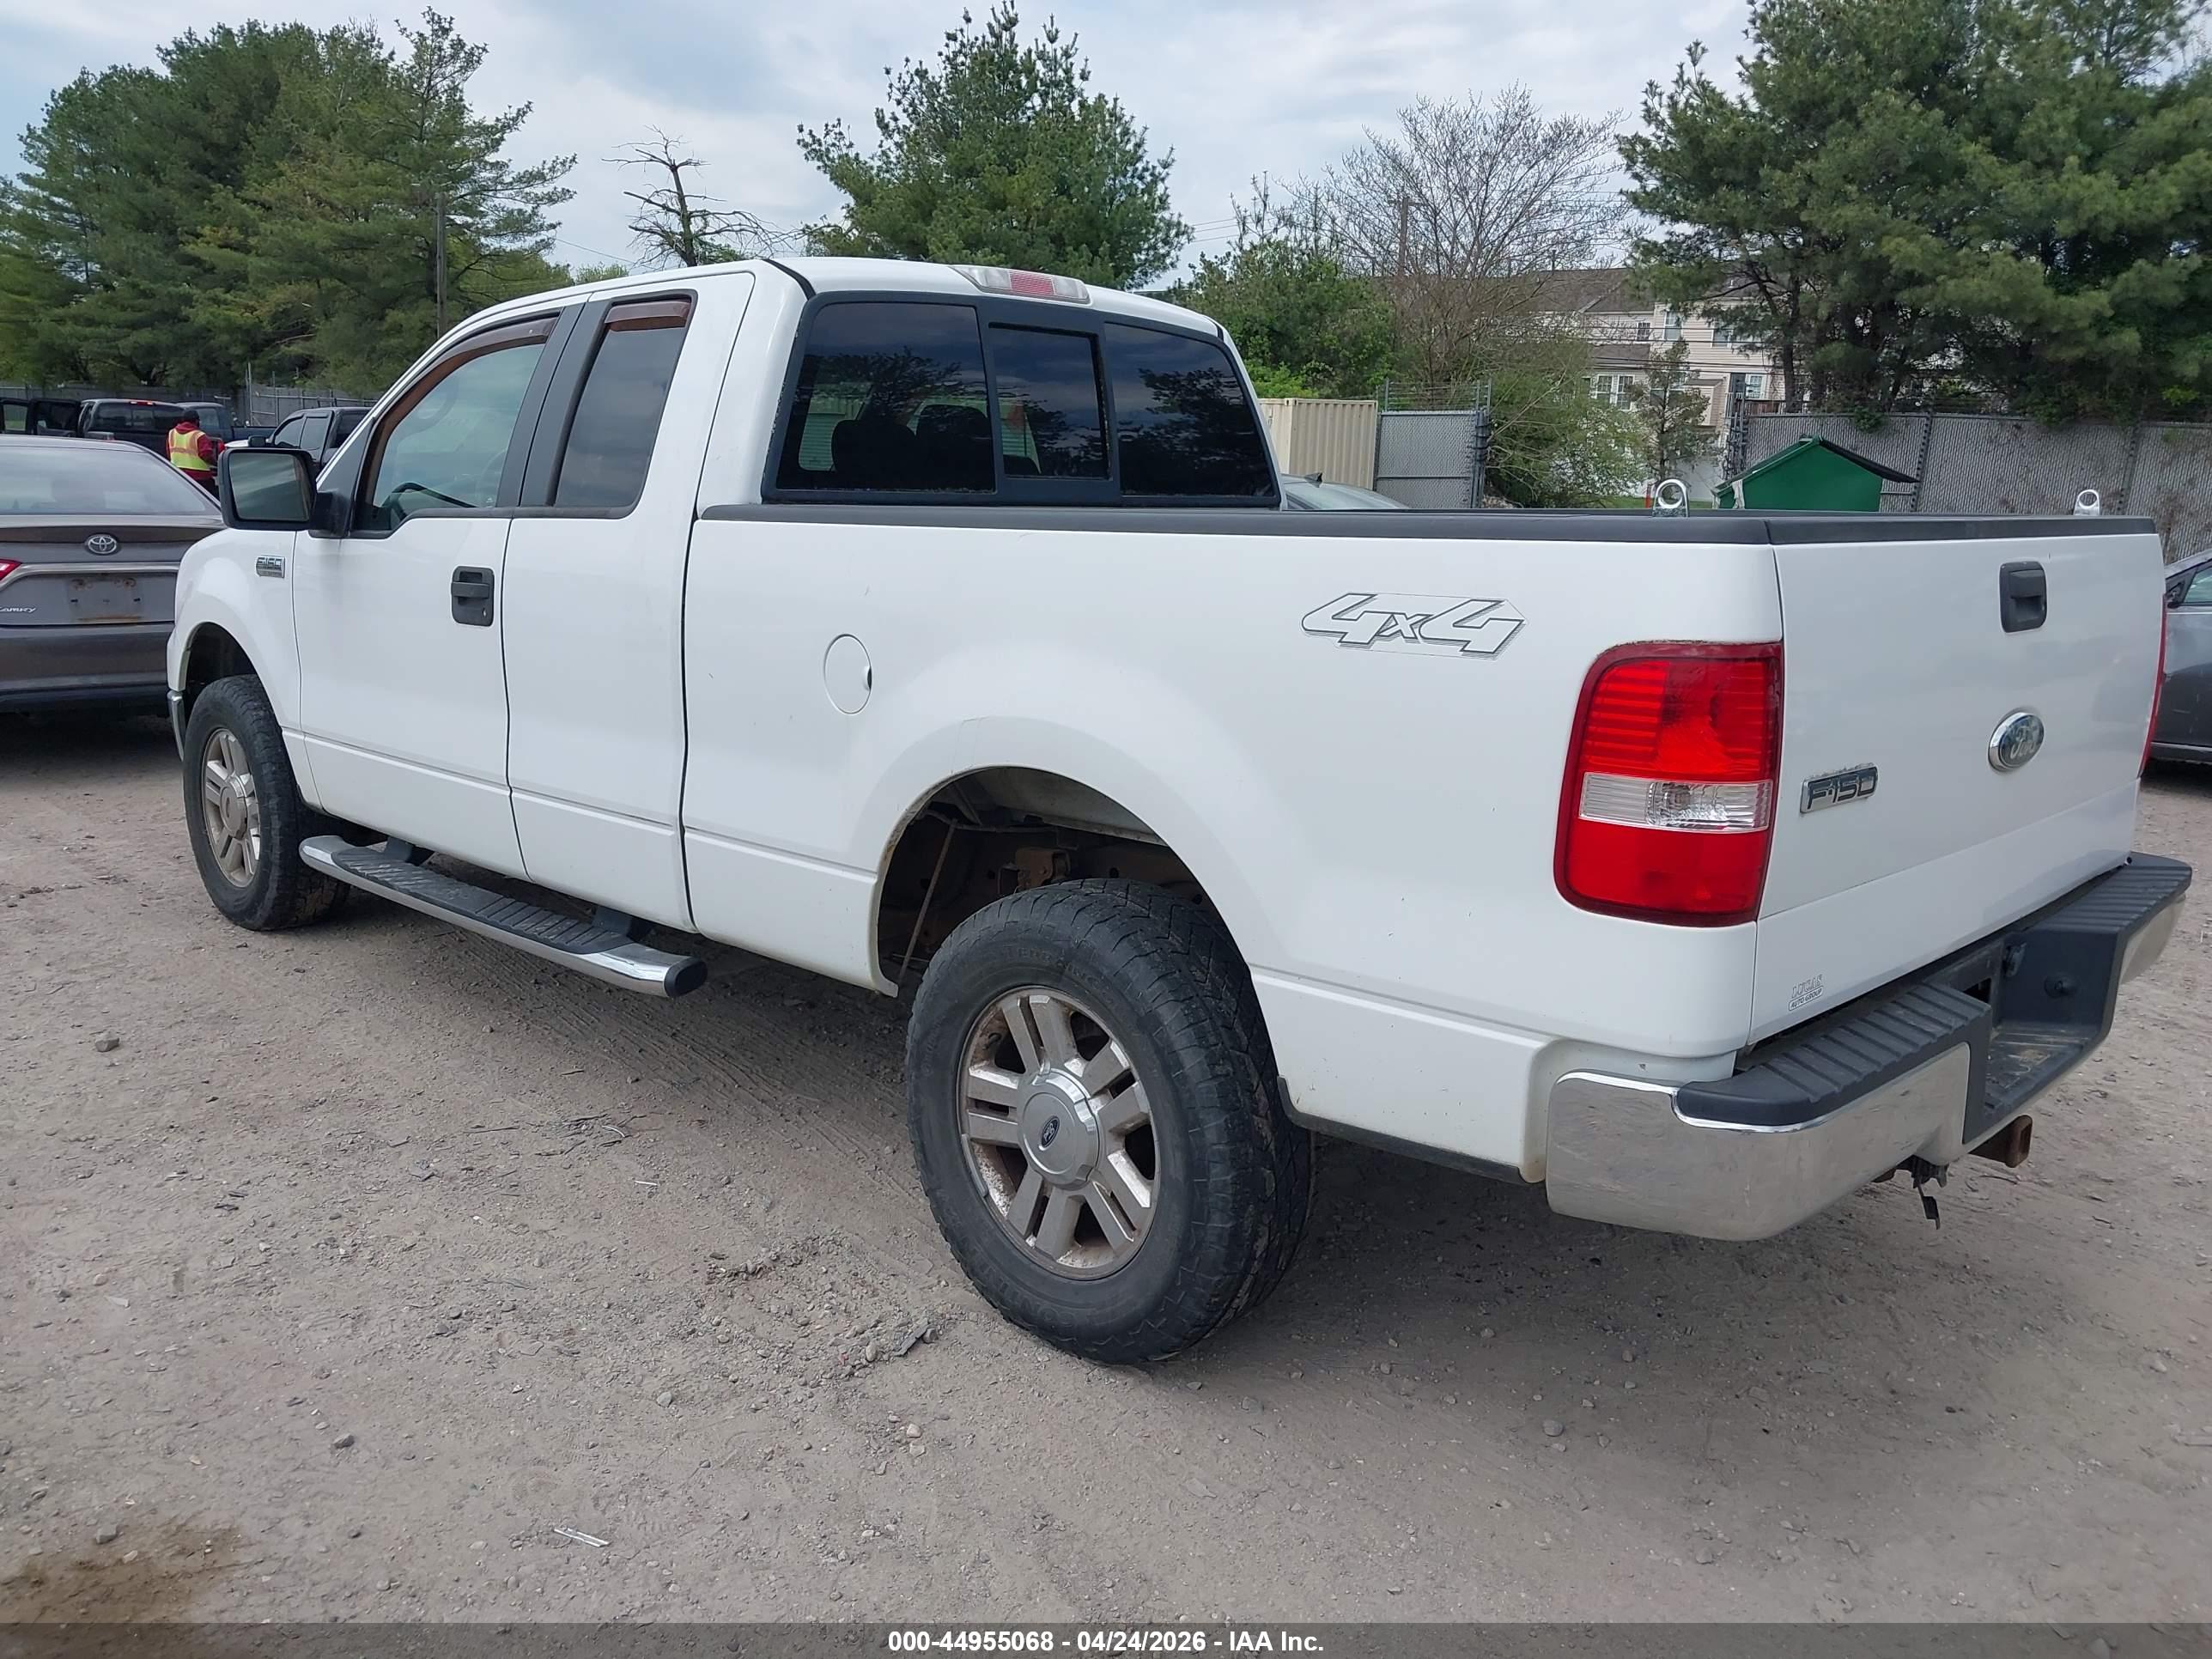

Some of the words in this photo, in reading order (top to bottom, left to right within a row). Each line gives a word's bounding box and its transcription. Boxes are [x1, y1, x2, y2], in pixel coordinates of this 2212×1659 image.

[1300, 592, 1526, 661] 4x4
[1790, 996, 1804, 1008] AUTO
[1804, 987, 1823, 1001] GROUP
